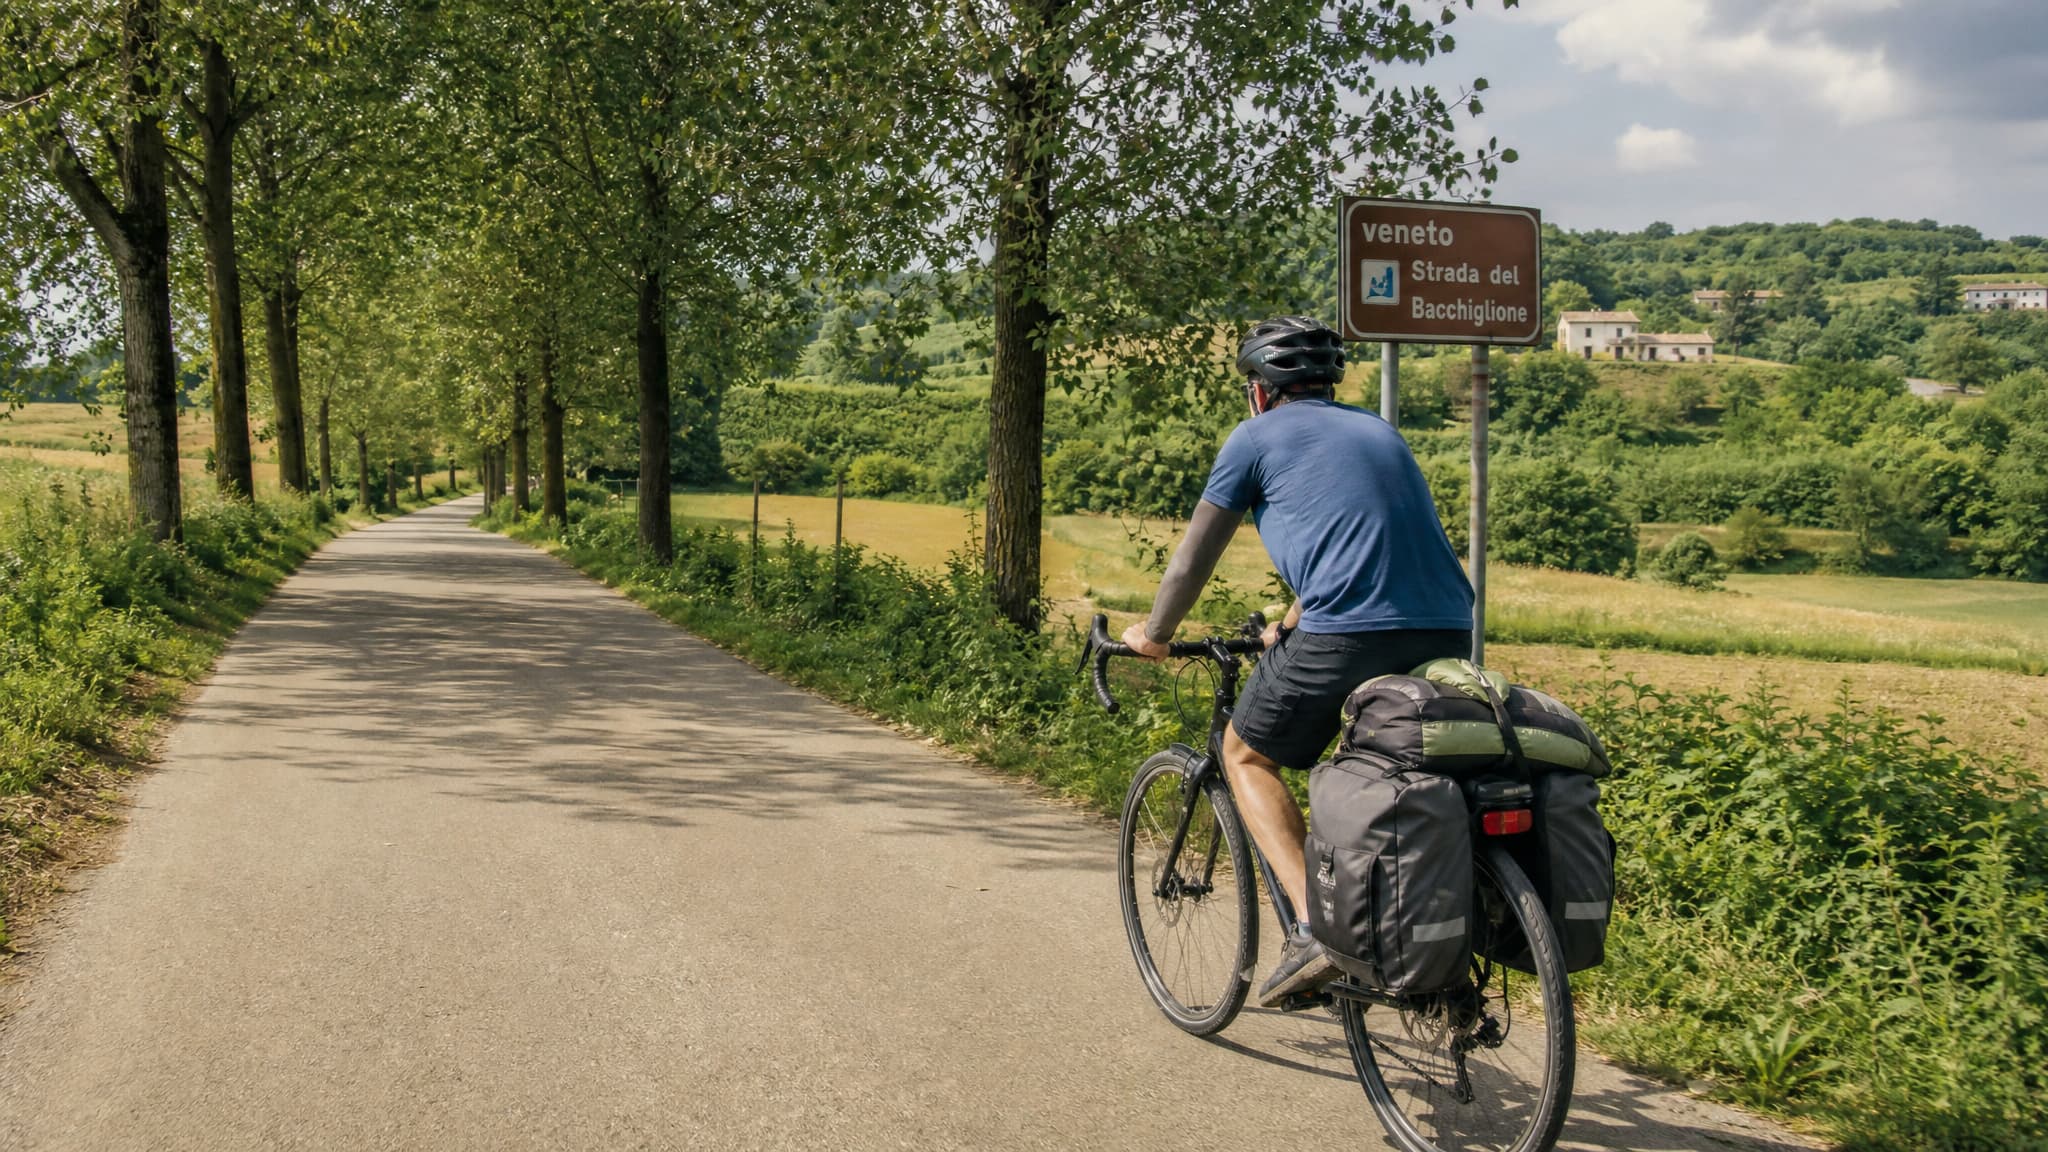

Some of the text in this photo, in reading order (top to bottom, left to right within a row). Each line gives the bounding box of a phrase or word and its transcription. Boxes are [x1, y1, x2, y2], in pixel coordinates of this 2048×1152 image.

[1362, 219, 1454, 246] veneto
[1411, 260, 1520, 285] Strada del
[1411, 296, 1528, 327] Bacchiglione
